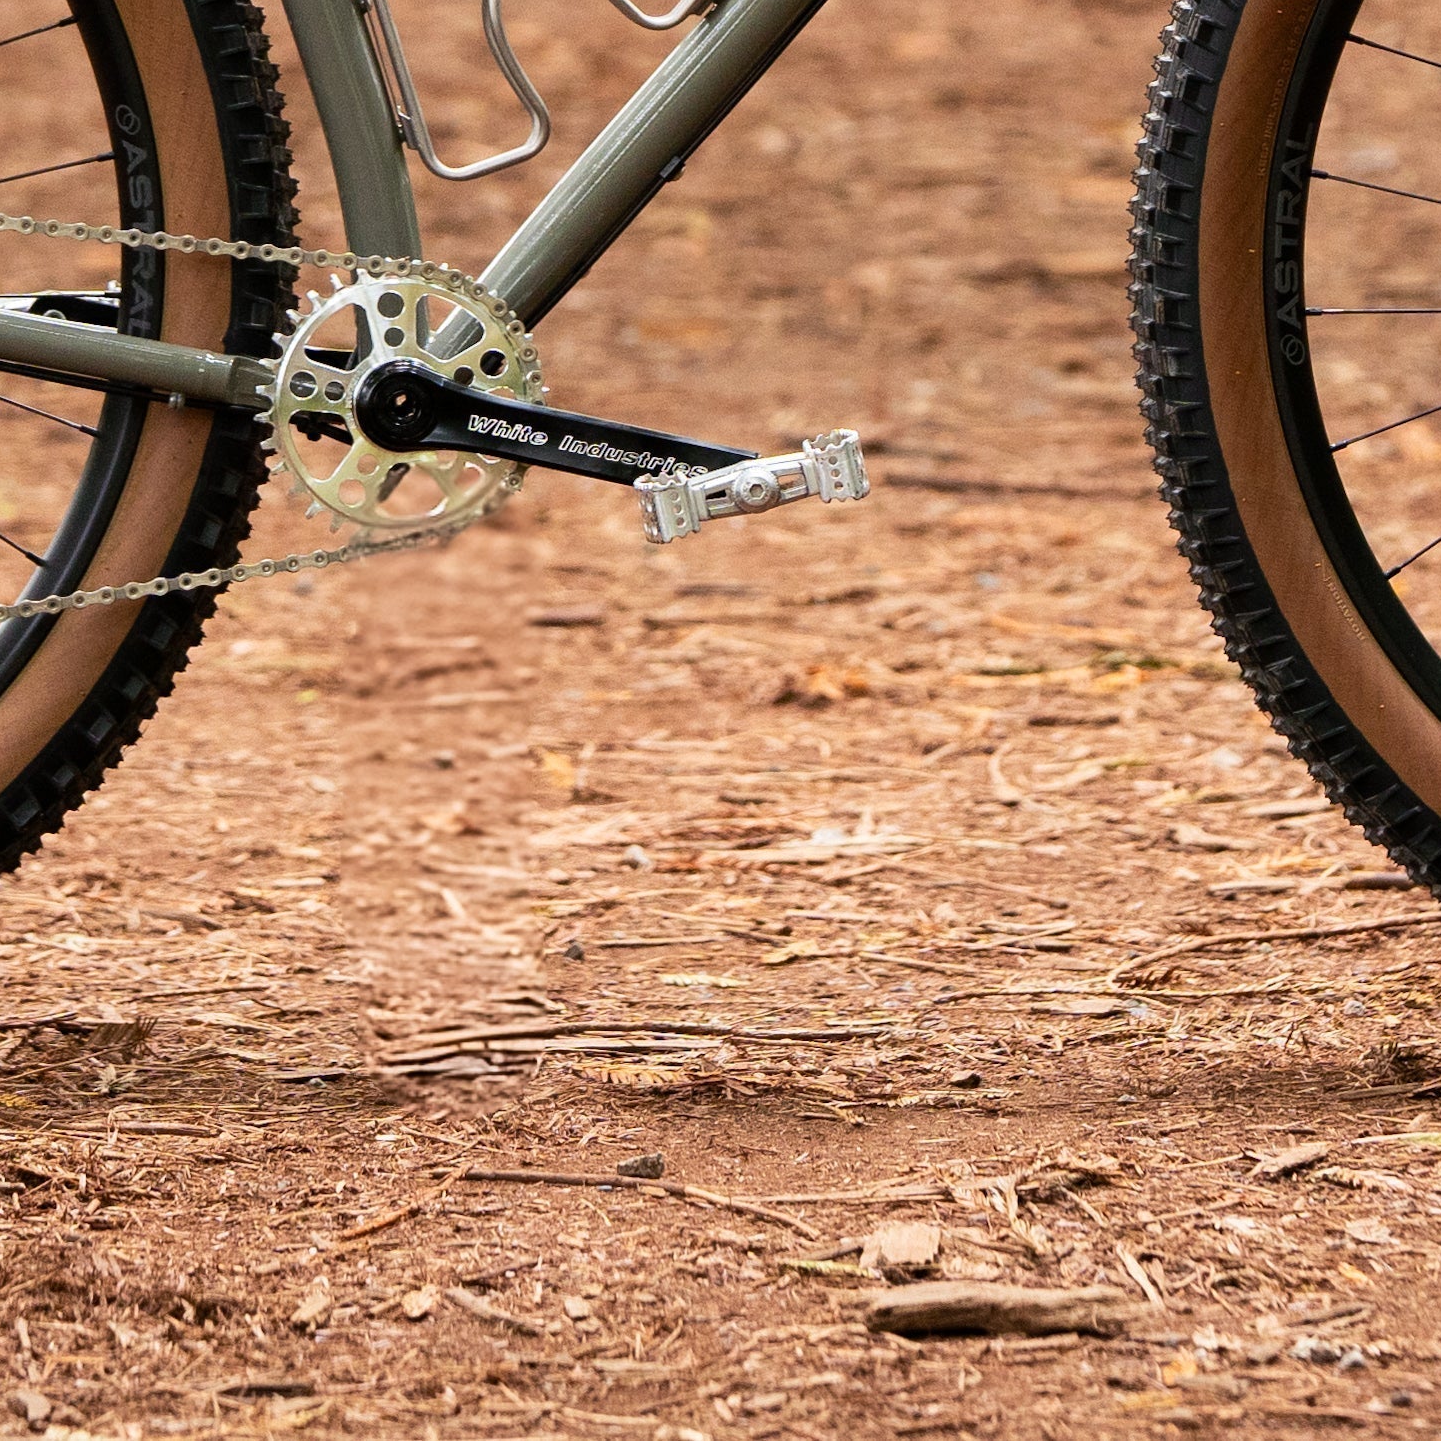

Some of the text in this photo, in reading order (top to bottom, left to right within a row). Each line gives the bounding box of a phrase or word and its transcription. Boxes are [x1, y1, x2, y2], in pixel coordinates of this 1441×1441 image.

[1273, 121, 1314, 330] ASTRAL
[467, 414, 710, 478] White Industries
